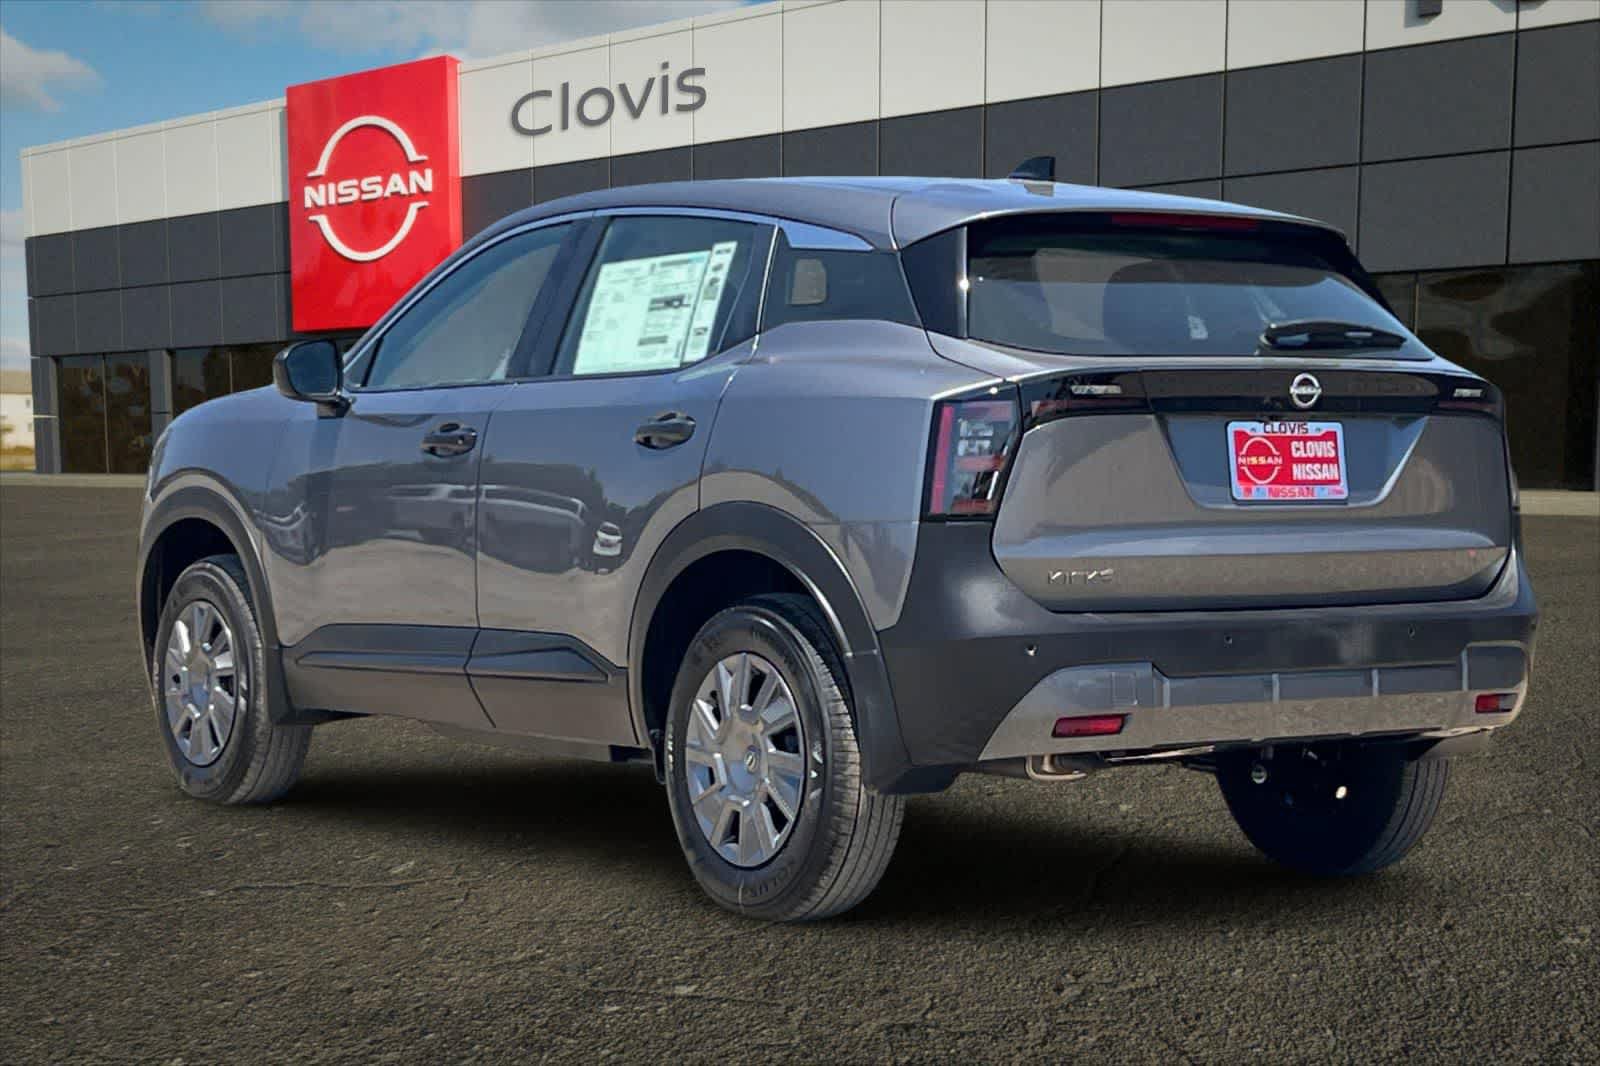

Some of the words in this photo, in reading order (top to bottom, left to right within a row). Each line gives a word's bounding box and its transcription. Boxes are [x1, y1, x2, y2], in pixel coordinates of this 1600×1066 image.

[304, 168, 434, 209] NISSAN
[1263, 422, 1309, 434] CLOVIS
[1290, 440, 1336, 458] CLOVIS
[1238, 455, 1282, 465] NISSAN
[1292, 463, 1340, 481] NISSAN
[1268, 486, 1315, 498] NISSAN
